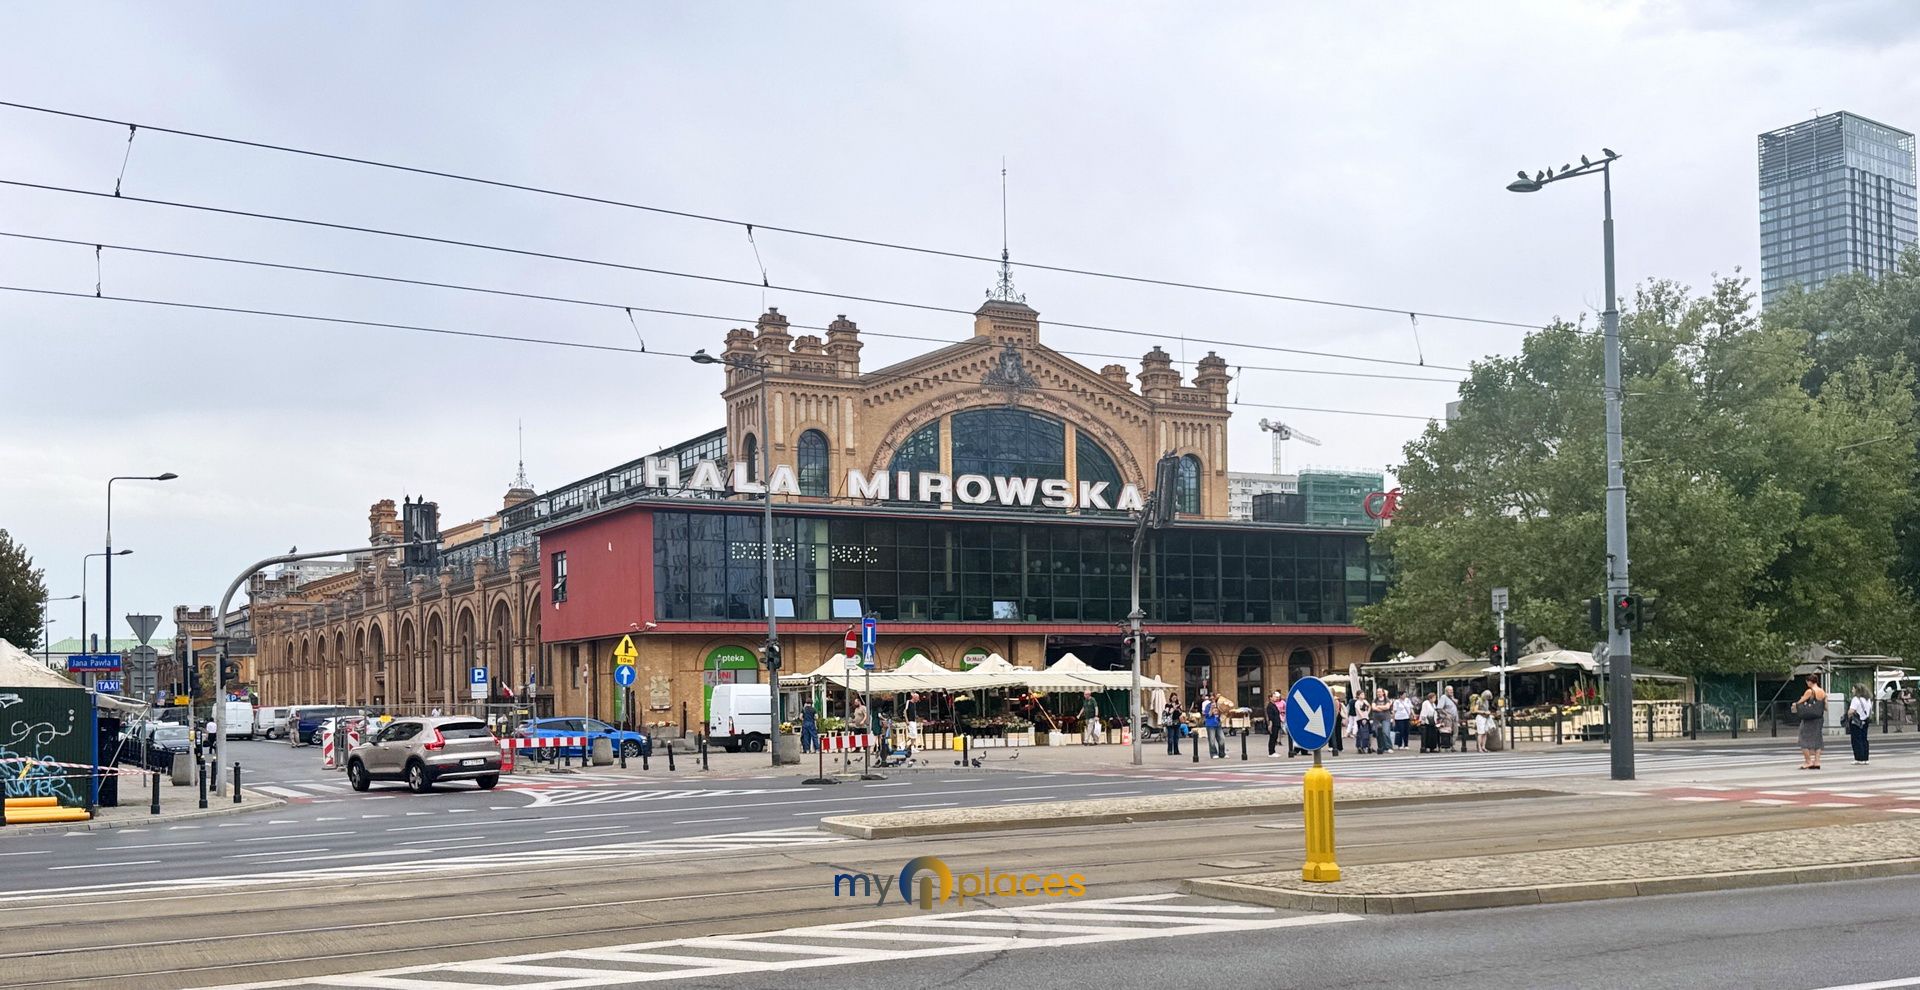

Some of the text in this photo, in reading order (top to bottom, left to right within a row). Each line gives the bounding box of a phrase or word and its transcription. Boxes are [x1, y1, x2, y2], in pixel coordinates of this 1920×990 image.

[644, 456, 1145, 511] HALA MIROWSKA
[732, 538, 795, 560] DZIEŃ
[831, 545, 878, 563] NOC
[72, 659, 88, 667] Jana
[90, 659, 111, 667] Pawła
[474, 669, 484, 682] P
[98, 681, 119, 690] TAXI
